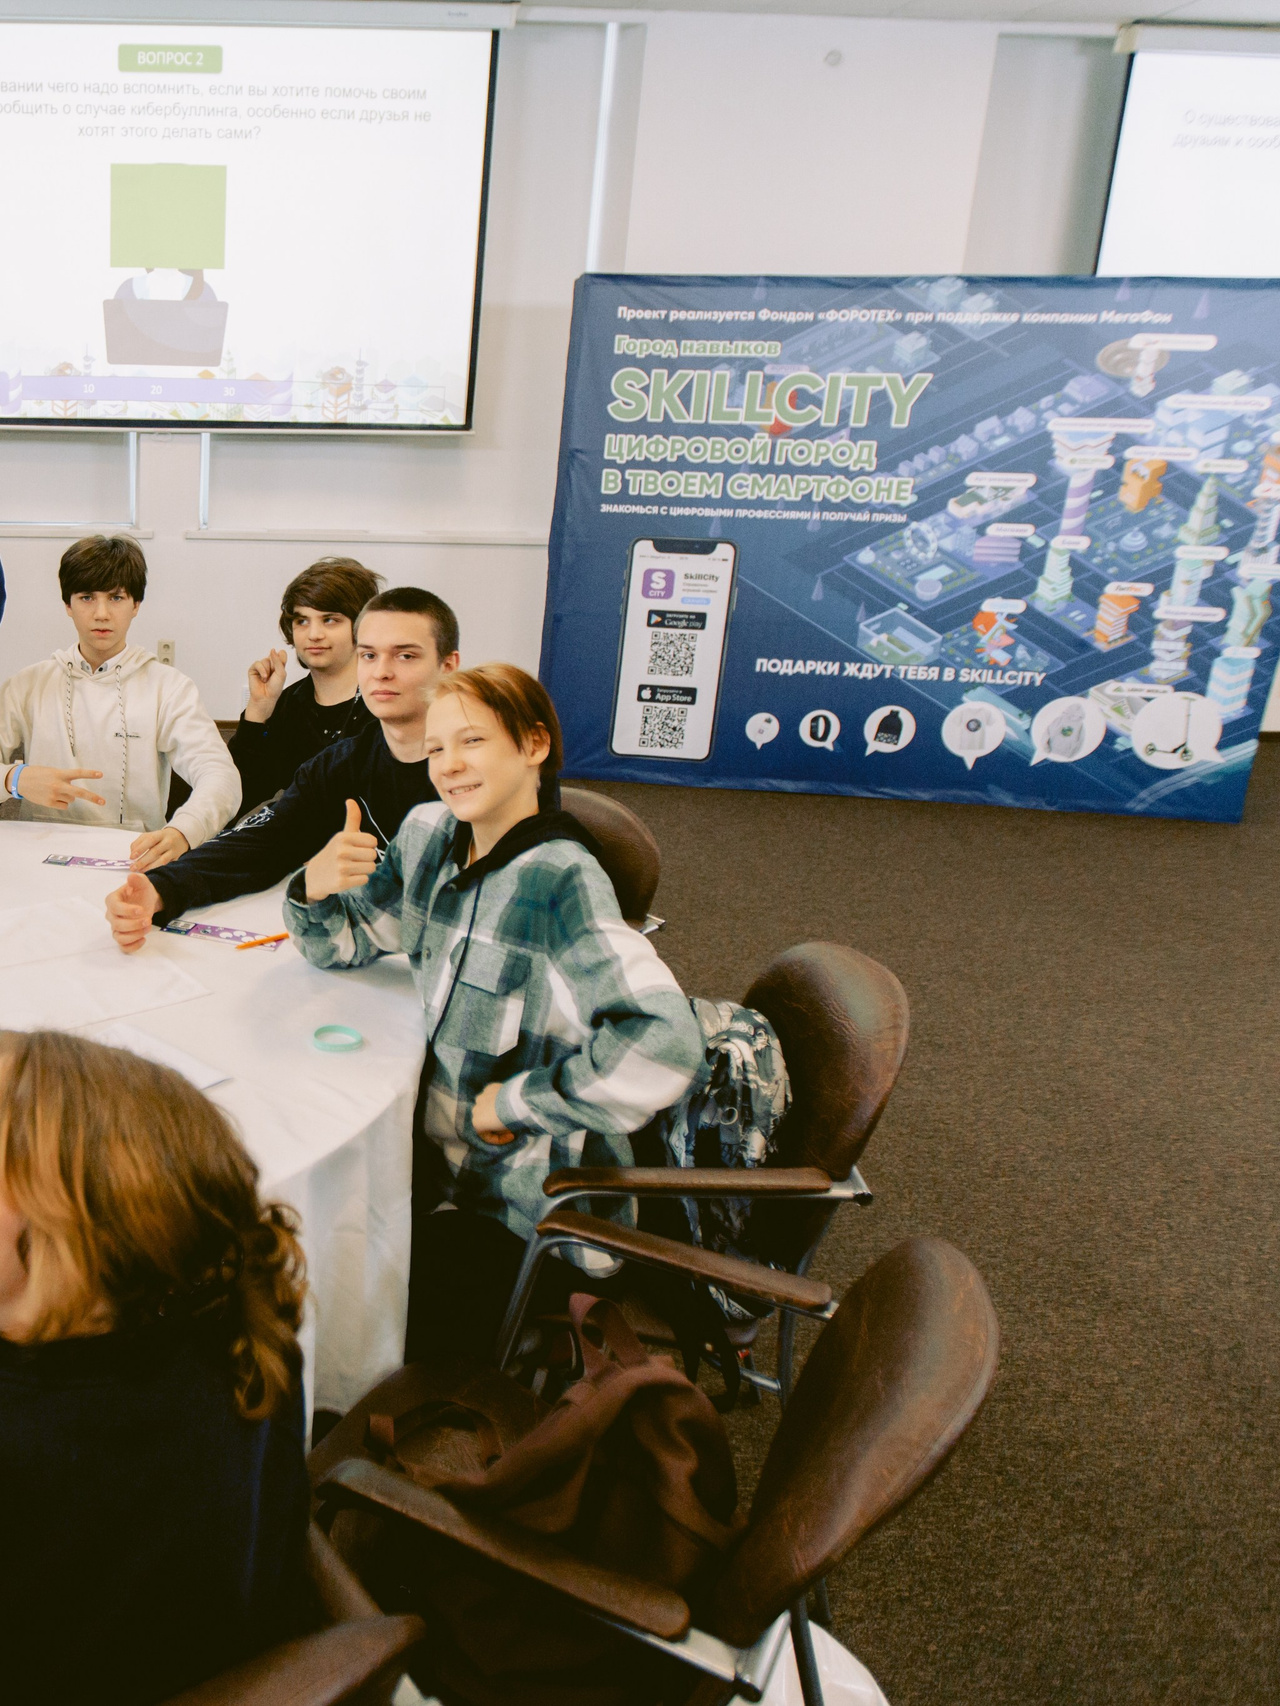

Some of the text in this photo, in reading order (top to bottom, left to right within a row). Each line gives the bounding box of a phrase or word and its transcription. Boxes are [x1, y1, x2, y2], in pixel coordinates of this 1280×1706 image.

[137, 51, 204, 66] ВОПРОС 2
[48, 80, 80, 94] чего
[83, 81, 118, 96] надо
[123, 83, 203, 98] вспомнить,
[209, 84, 243, 97] если
[248, 85, 267, 97] вы
[272, 86, 319, 98] хотите
[324, 87, 377, 100] помочь
[382, 88, 427, 101] своим
[62, 103, 71, 115] о
[76, 104, 126, 119] случае
[131, 102, 242, 120] кибербуллинга,
[247, 104, 316, 119] особенно
[321, 109, 355, 121] если
[359, 109, 409, 125] друзья
[414, 110, 431, 123] не
[1184, 109, 1280, 129] О существова
[77, 124, 261, 141] хотят этого делать сами?
[1172, 134, 1232, 150] друзьям
[617, 306, 1172, 325] Проект реализуется Фондом «ФОРОТЕХ» при поддержке компании МегаФон
[613, 334, 782, 358] Город навыков
[83, 383, 95, 394] 10
[151, 384, 163, 395] 20
[223, 386, 236, 397] 30
[606, 366, 934, 428] SKILLCITY
[604, 432, 877, 472] ЦИФРОВОЙ ГОРОД
[601, 468, 914, 503] В ТВОЕМ СМАРТФОНЕ
[600, 503, 907, 524] ЗНАКОМЬСЯ С ЦИФРОВЫМИ ПРОФЕССИЯМИ И ПОЛУЧАЙ ПРИЗЫ
[649, 571, 667, 591] S
[684, 573, 720, 583] SkillCity
[649, 590, 666, 598] CITY
[664, 618, 703, 629] Google play
[755, 657, 1047, 686] ПОДАРКИ ЖДУТ ТЕБЯ В SKILLCITY
[655, 692, 693, 703] App Store
